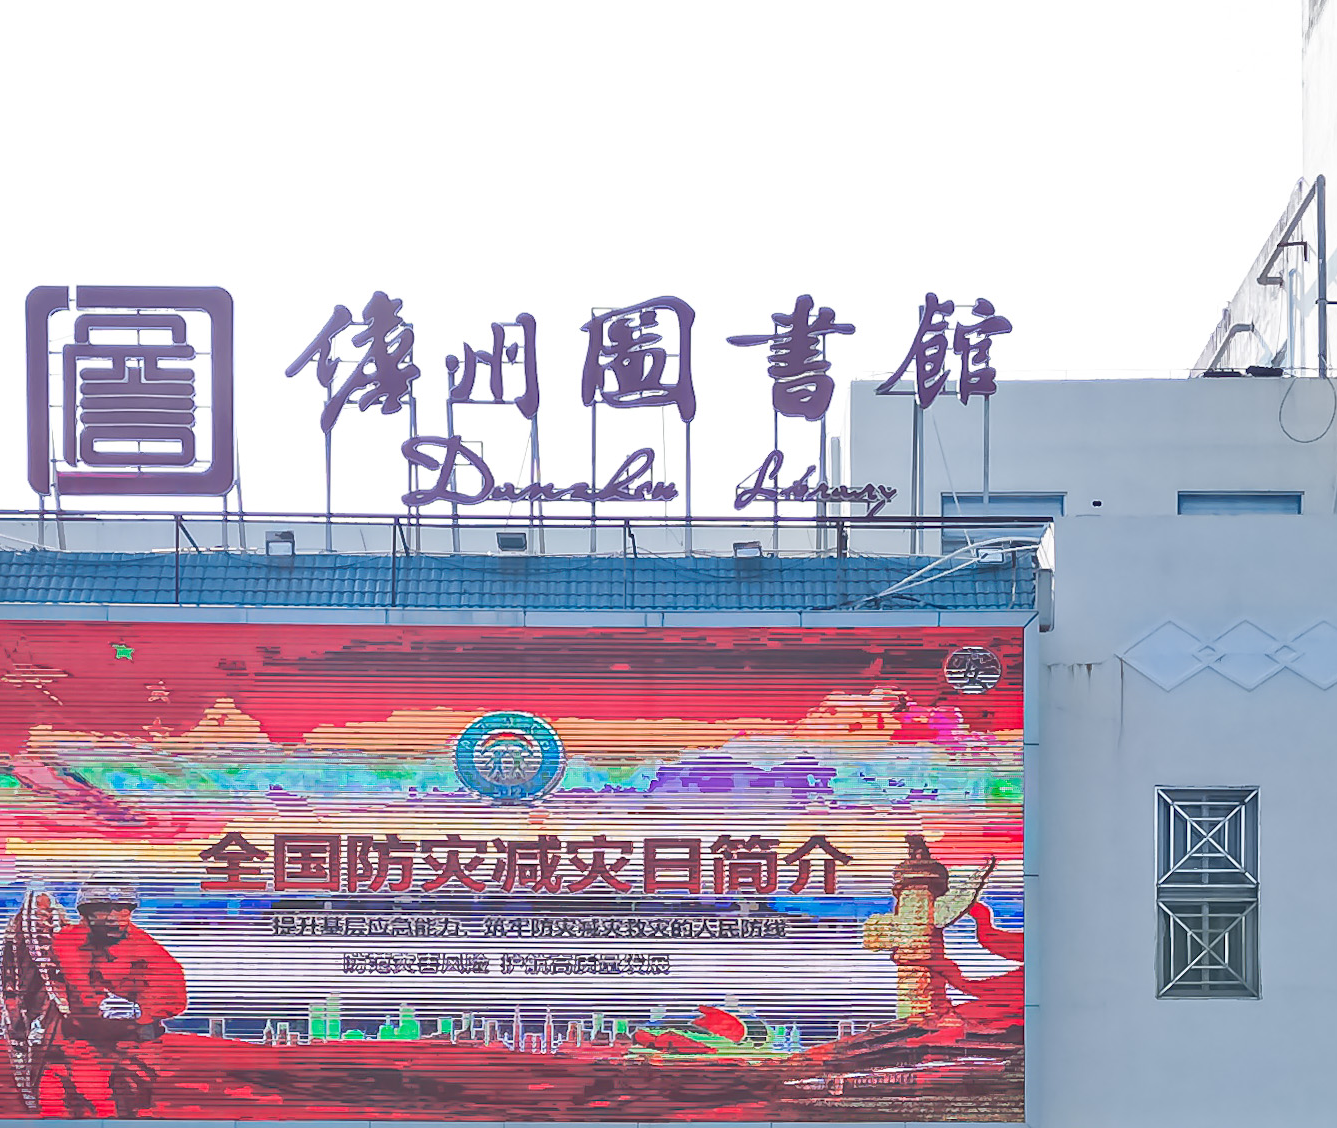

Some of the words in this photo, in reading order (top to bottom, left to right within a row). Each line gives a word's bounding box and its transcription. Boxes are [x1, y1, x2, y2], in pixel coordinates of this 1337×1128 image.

[197, 832, 852, 896] 全国防灾减灾日简介
